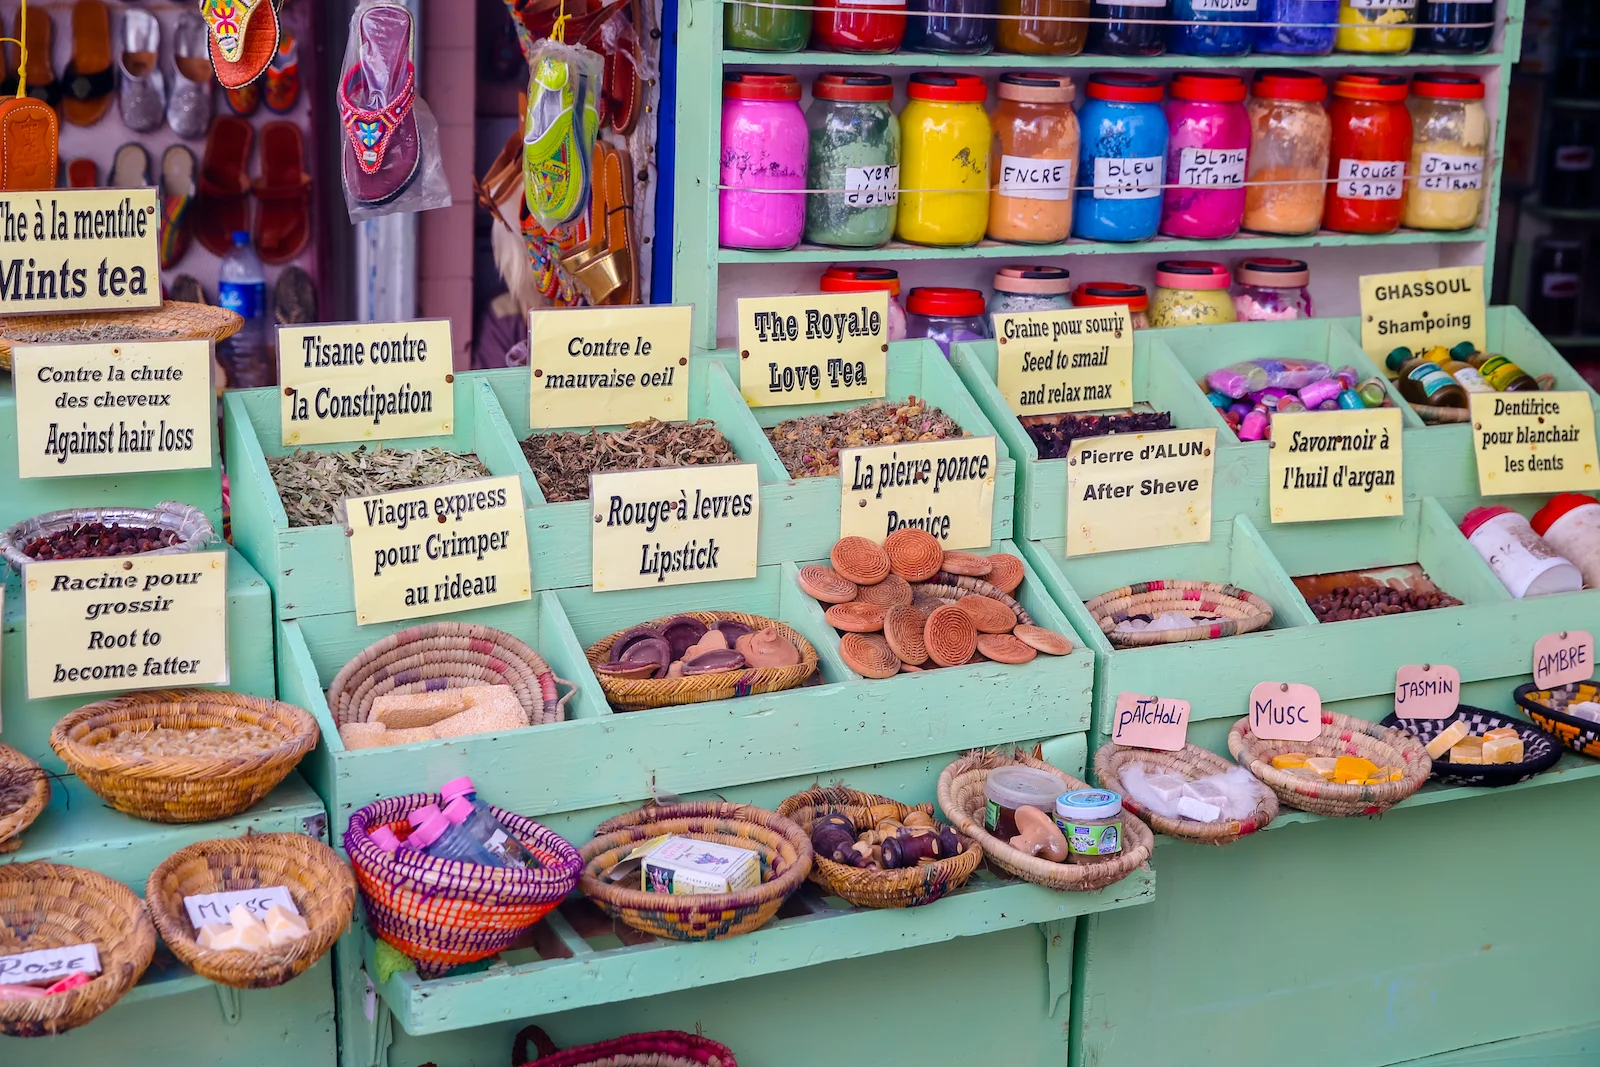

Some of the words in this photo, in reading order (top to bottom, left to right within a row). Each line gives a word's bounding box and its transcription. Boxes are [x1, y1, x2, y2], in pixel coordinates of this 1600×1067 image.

[1003, 164, 1065, 184] ENCRE
[1349, 163, 1399, 180] ROUGE
[33, 199, 46, 241] à
[50, 199, 69, 241] la
[73, 198, 148, 240] menthe
[0, 258, 87, 301] Mints
[97, 257, 148, 297] tea
[1375, 278, 1472, 301] GHASSOUL
[754, 311, 799, 343] The
[805, 306, 882, 344] Royale
[1004, 317, 1049, 340] Graine
[1052, 318, 1083, 343] pour
[1085, 311, 1124, 334] sourir
[1377, 313, 1472, 335] Shampoing
[302, 334, 365, 368] Tisane
[369, 332, 427, 364] contre
[567, 336, 631, 358] Contre
[633, 336, 652, 356] le
[1021, 349, 1055, 373] Seed
[1056, 350, 1069, 370] to
[1071, 345, 1110, 369] smail
[37, 366, 104, 384] Contre
[107, 366, 126, 383] la
[130, 365, 184, 382] chute
[544, 368, 636, 390] mauvaise
[640, 366, 675, 387] oeil
[768, 362, 821, 393] Love
[827, 358, 868, 388] Tea
[54, 391, 90, 409] des
[93, 389, 172, 408] cheveux
[291, 388, 309, 421] la
[314, 382, 433, 425] Constipation
[1020, 383, 1045, 406] and
[1047, 382, 1080, 404] relax
[1083, 383, 1112, 401] max
[1494, 398, 1560, 416] Dentifrice
[44, 421, 115, 464] Against
[117, 420, 156, 452] hair
[159, 420, 195, 452] loss
[1289, 430, 1338, 453] Savon
[1341, 428, 1377, 451] noir
[1379, 427, 1390, 450] à
[1482, 431, 1514, 450] pour
[1516, 424, 1580, 444] blanchair
[1081, 449, 1134, 465] Pierre
[1139, 441, 1203, 460] d'ALUN
[1505, 455, 1525, 473] les
[1528, 454, 1564, 471] dents
[851, 455, 874, 491] La
[876, 451, 931, 499] pierre
[933, 453, 990, 493] ponce
[1283, 466, 1329, 489] l'huil
[1332, 465, 1396, 493] d'argan
[1082, 484, 1134, 501] After
[1140, 478, 1199, 496] Sheve
[364, 498, 429, 529] Viagra
[434, 488, 507, 521] express
[607, 495, 671, 532] Rouge
[676, 489, 688, 521] à
[692, 488, 753, 520] levres
[374, 543, 421, 576] pour
[426, 530, 510, 561] Grimper
[640, 538, 720, 582] Lipstick
[51, 573, 138, 592] Racine
[142, 571, 203, 591] pour
[404, 585, 430, 606] au
[434, 573, 498, 602] rideau
[85, 596, 174, 620] grossir
[87, 629, 138, 651] Root
[142, 628, 162, 646] to
[53, 663, 139, 684] become
[142, 656, 200, 677] fatter
[1537, 644, 1586, 680] AMBRE
[198, 897, 273, 919] MSC
